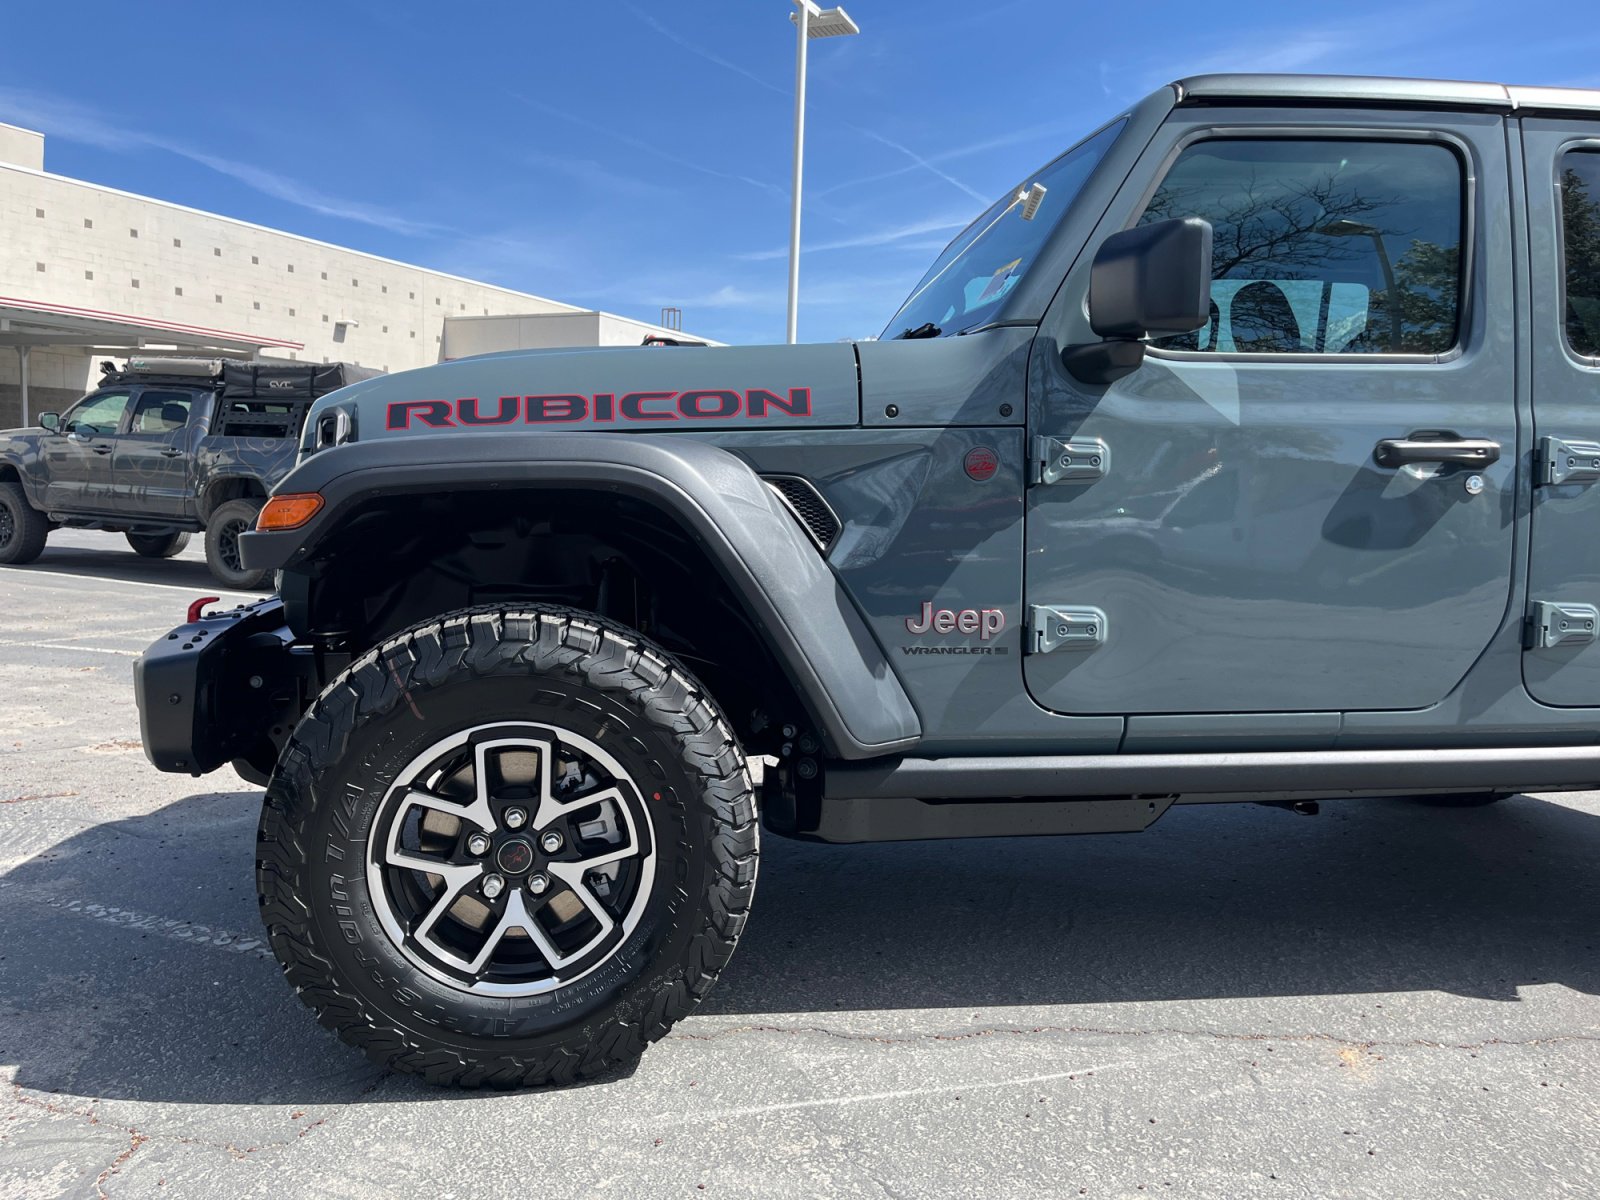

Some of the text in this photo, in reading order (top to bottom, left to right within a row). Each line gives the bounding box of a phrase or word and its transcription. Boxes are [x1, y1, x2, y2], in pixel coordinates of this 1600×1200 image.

[385, 387, 812, 431] RUBICON
[906, 600, 1005, 640] Jeep
[901, 646, 992, 655] WRANGLER
